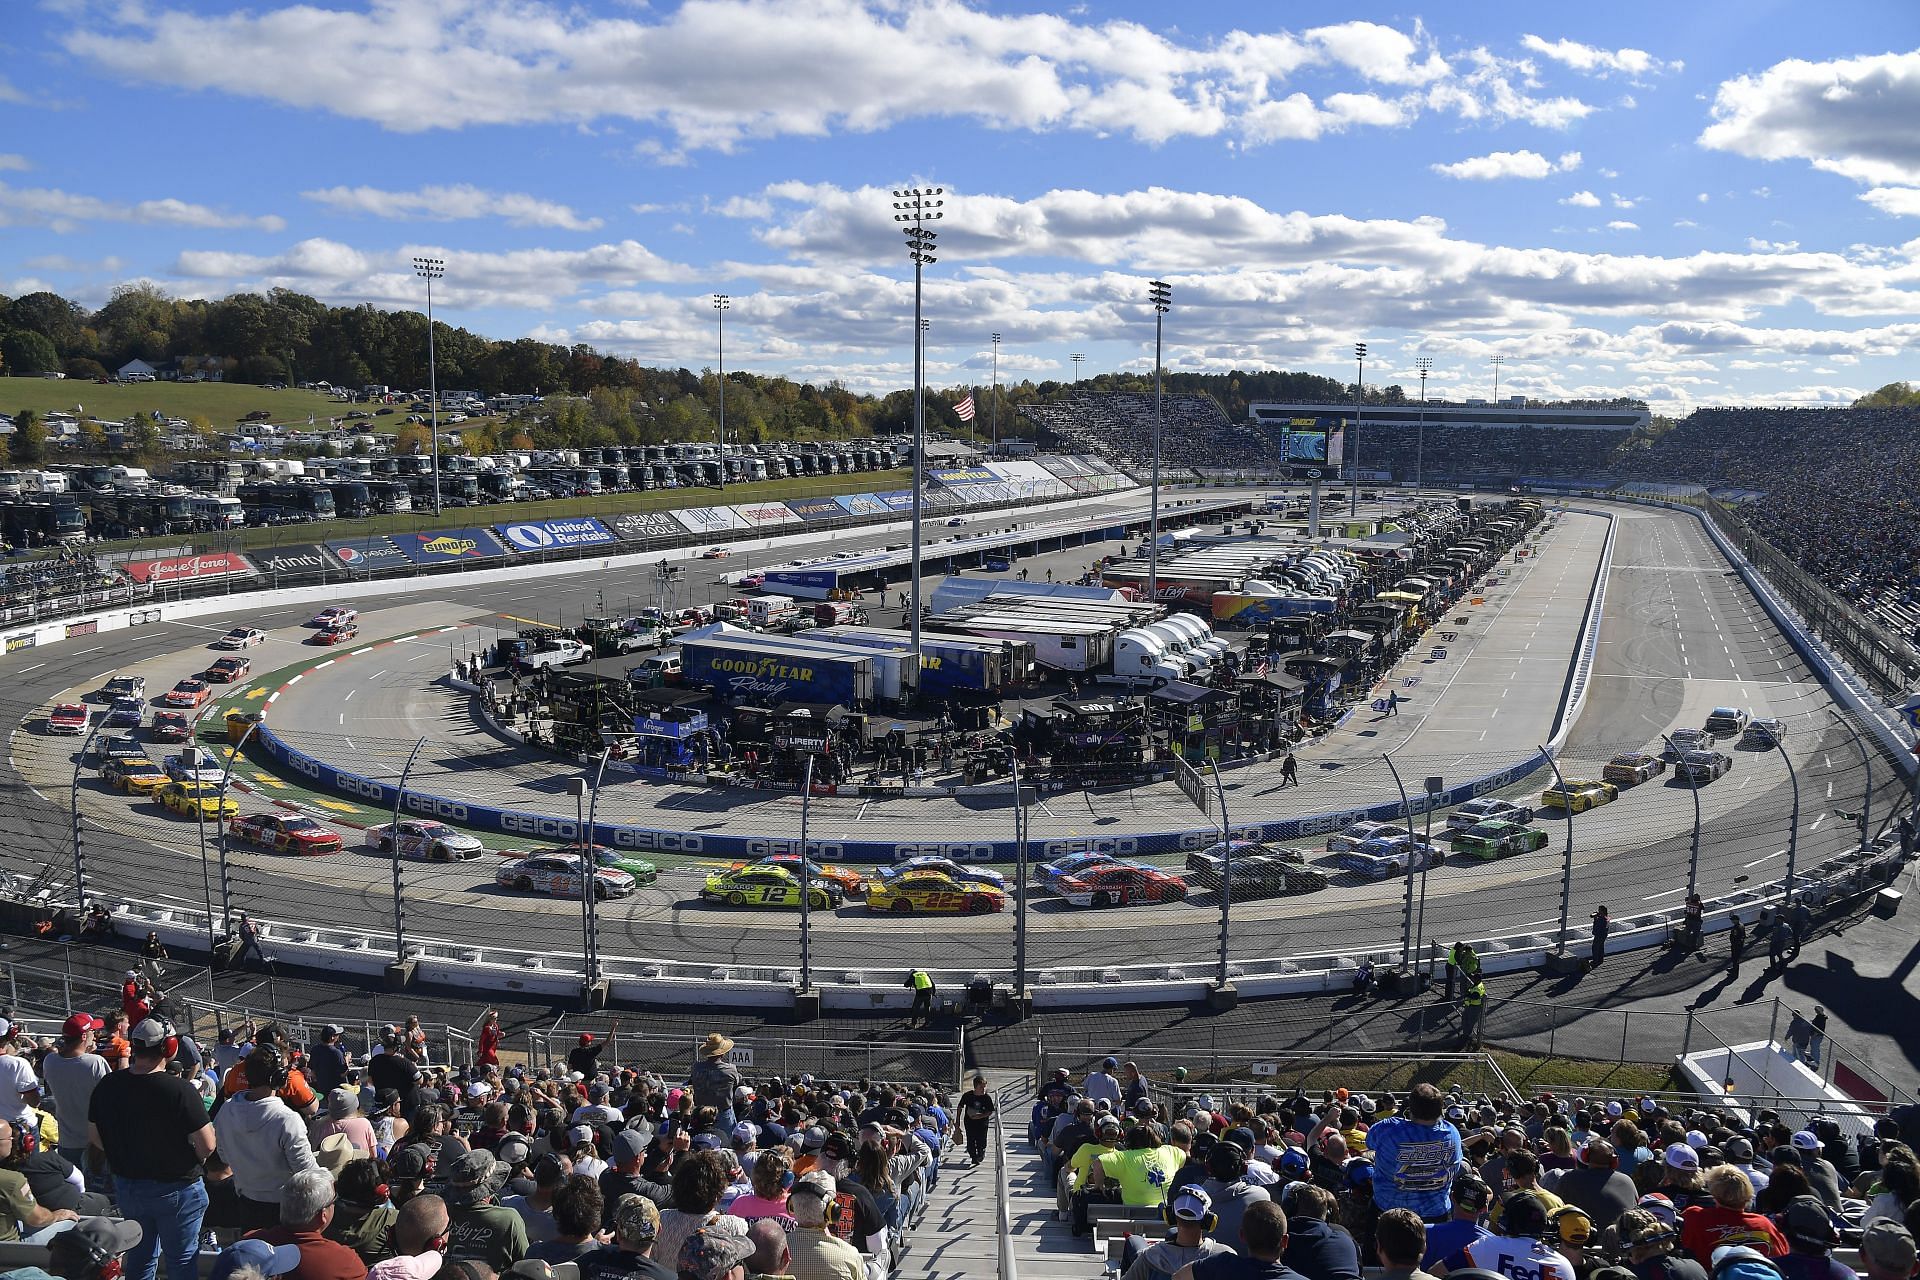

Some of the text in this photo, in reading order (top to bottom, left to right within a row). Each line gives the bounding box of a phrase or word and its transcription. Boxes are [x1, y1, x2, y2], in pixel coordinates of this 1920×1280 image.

[544, 520, 594, 535] United
[626, 514, 655, 526] DEAD
[559, 531, 610, 544] Rentals
[638, 524, 680, 535] TOOLS
[423, 539, 477, 553] SUNOCO
[148, 556, 231, 580] Jesse Jones
[264, 553, 323, 571] xfinity
[1165, 585, 1191, 599] FAST
[6, 632, 35, 650] WynnBET
[1443, 632, 1457, 641] 37
[711, 658, 814, 681] GOODYEAR
[728, 676, 790, 696] Racing
[1372, 699, 1390, 711] 41
[643, 719, 664, 734] Kroger
[789, 737, 825, 746] LIBERTY
[1086, 735, 1101, 744] ally
[288, 751, 319, 778] GEICO
[336, 772, 382, 800] GEICO
[883, 787, 903, 796] xfinity
[1178, 764, 1202, 803] xfinity
[1473, 769, 1512, 797] GEICO
[407, 793, 468, 820] GEICO
[1398, 791, 1452, 817] GEICO
[500, 811, 577, 839] GEICO
[1299, 809, 1368, 834] GEICO
[614, 828, 703, 851] GEICO
[1044, 837, 1138, 858] GEICO
[746, 839, 843, 859] GEICO
[895, 844, 994, 859] GEICO
[761, 887, 787, 902] 12
[925, 892, 964, 908] 22
[732, 1051, 750, 1063] AAA
[1497, 1253, 1563, 1280] FedE
